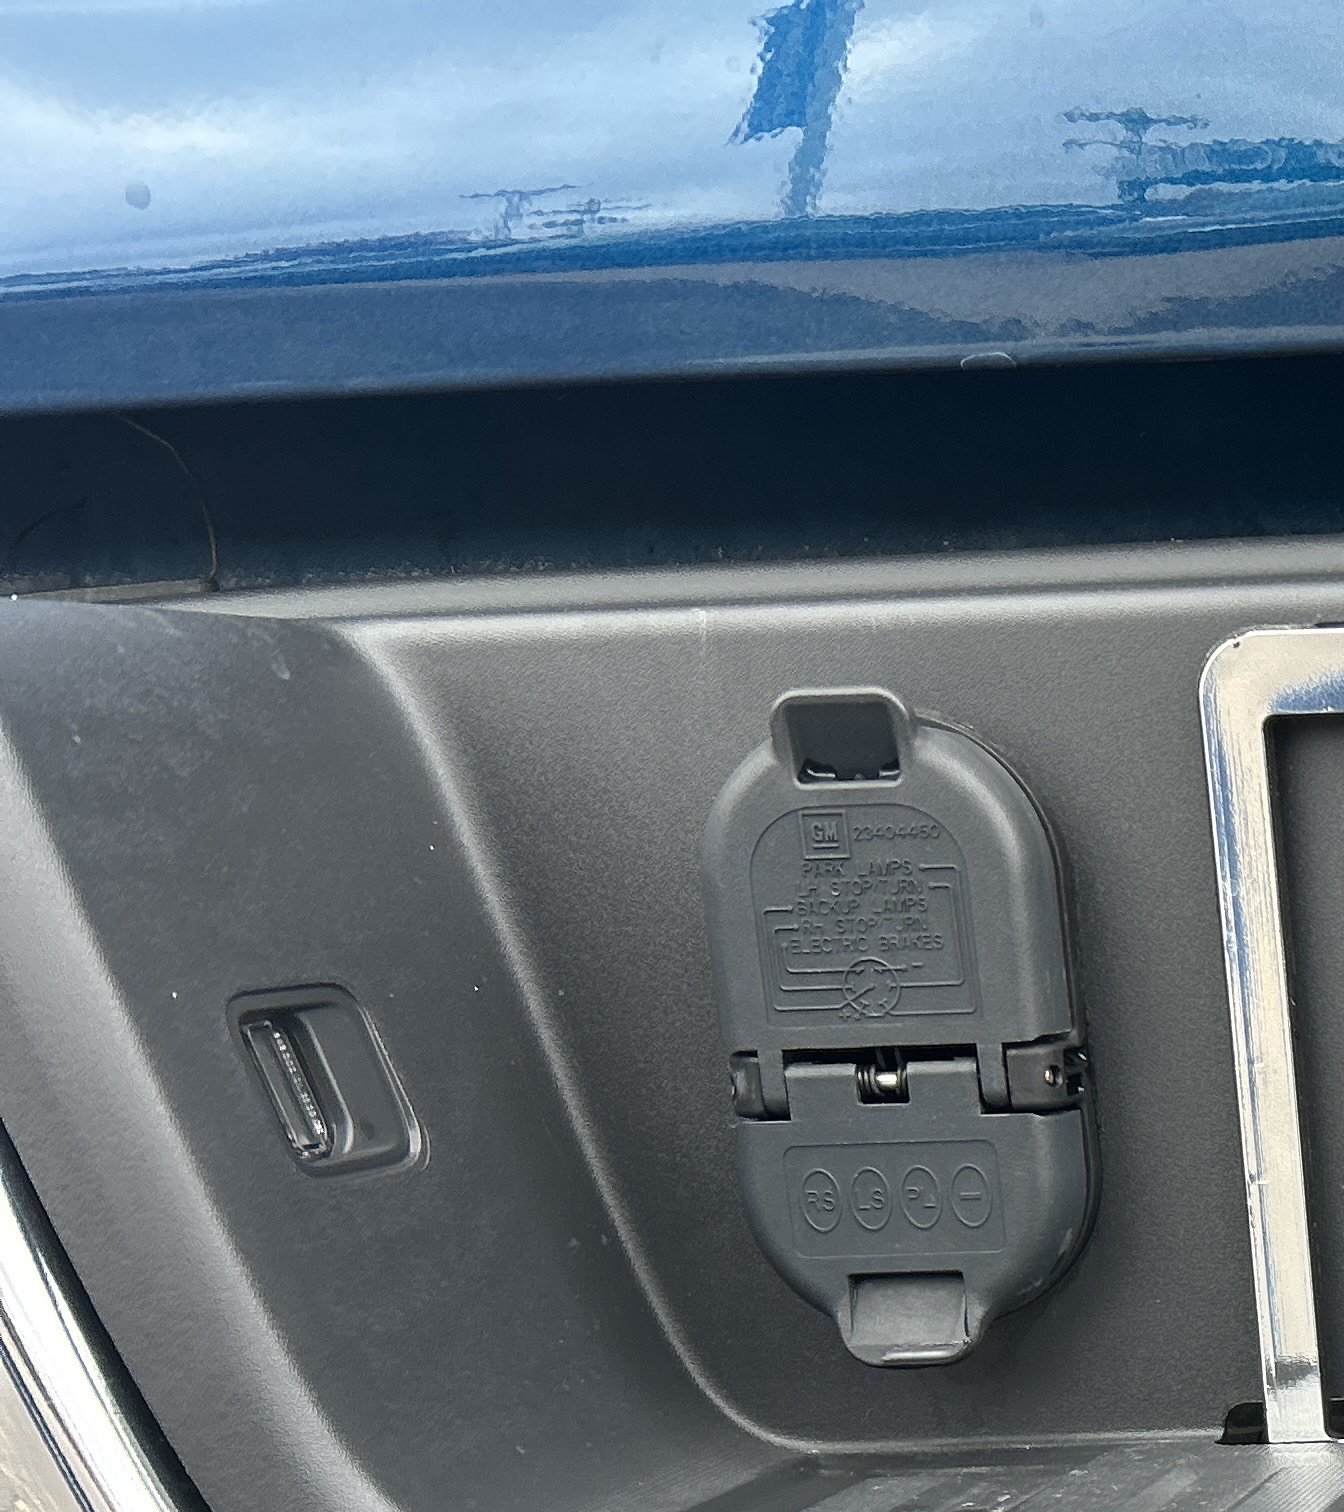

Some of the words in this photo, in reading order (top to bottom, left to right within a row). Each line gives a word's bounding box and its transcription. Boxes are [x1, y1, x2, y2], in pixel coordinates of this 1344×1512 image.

[811, 821, 839, 842] GM
[801, 861, 846, 879] PARK
[857, 858, 913, 877] LAMPS
[797, 899, 860, 917] BACKUP
[871, 896, 928, 914] LAMPS
[791, 936, 871, 955] ELECTRIC
[879, 934, 944, 951] BRAKES
[806, 1189, 836, 1212] RS
